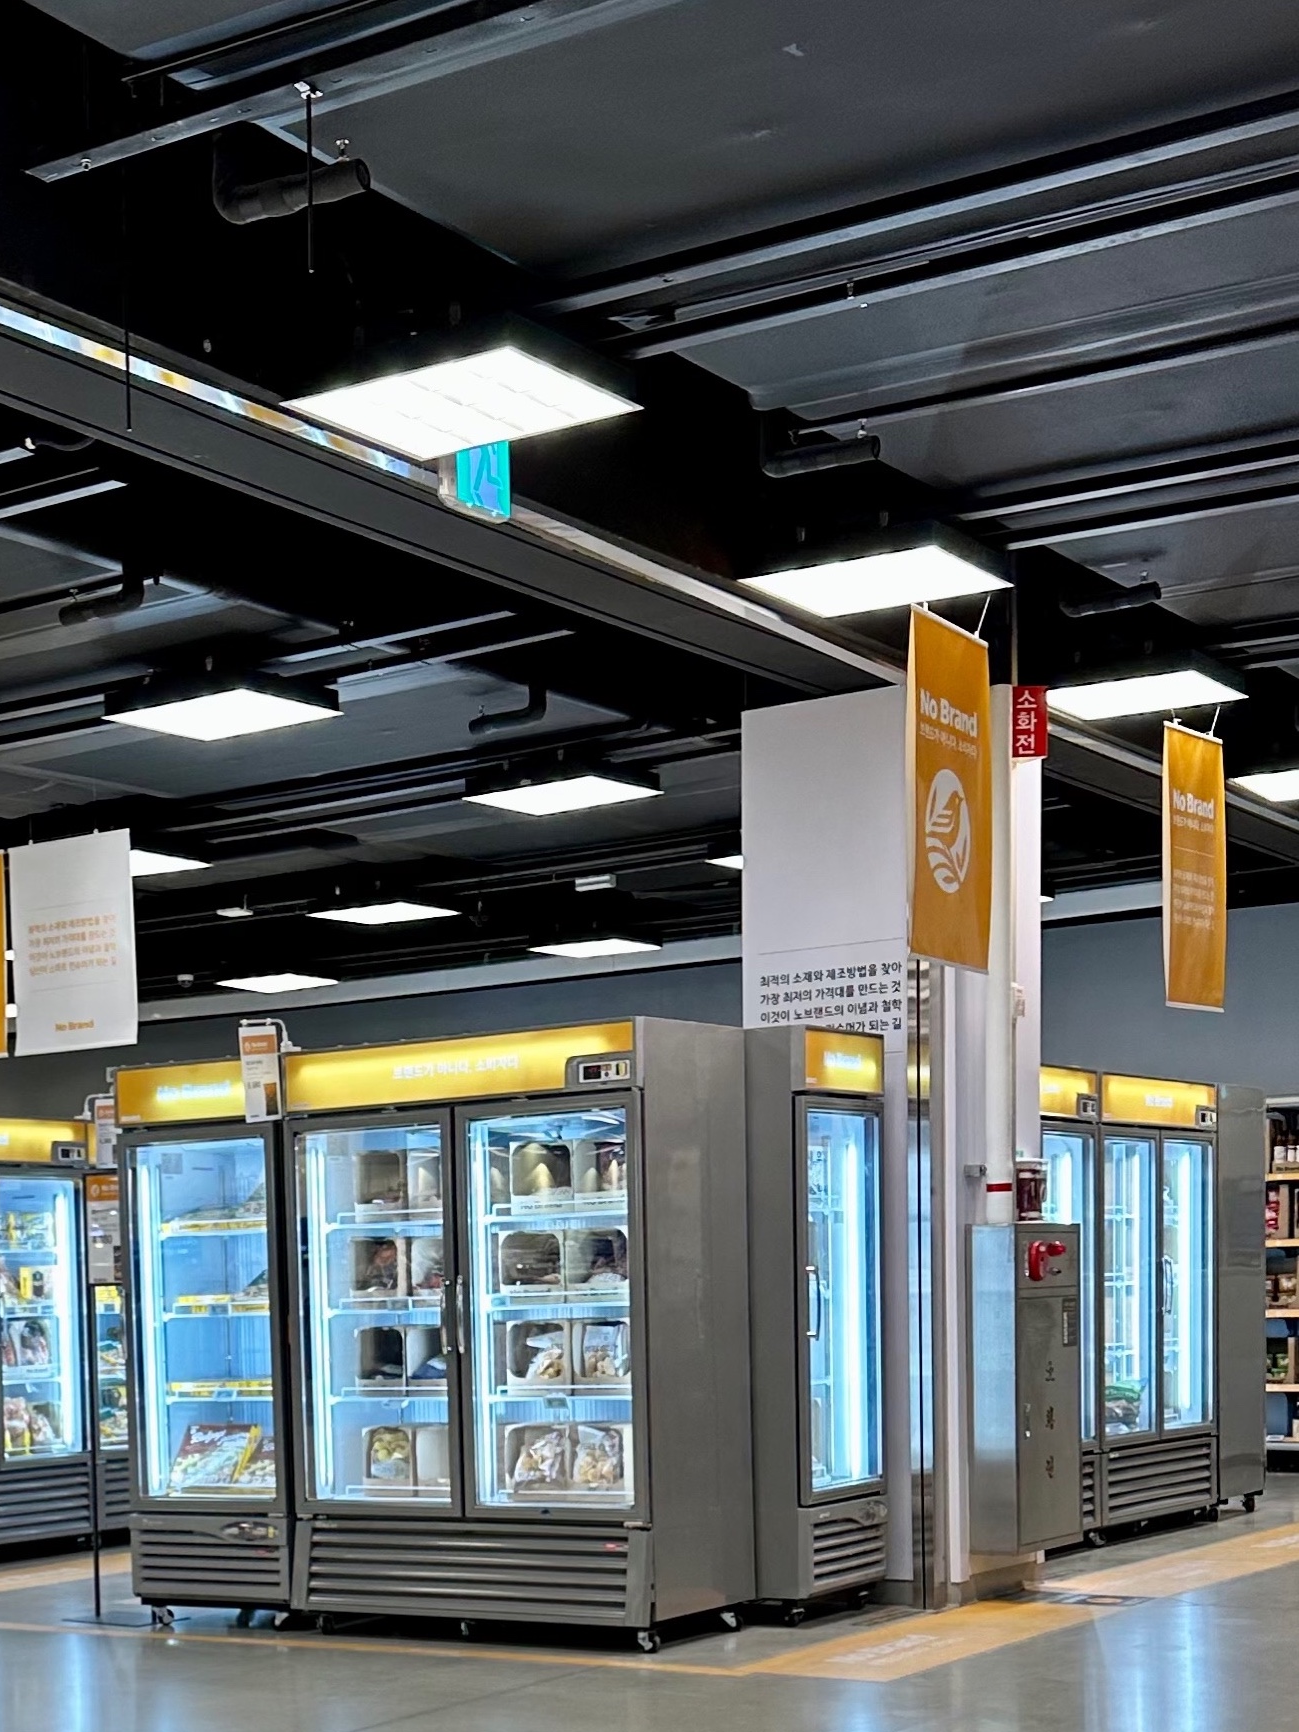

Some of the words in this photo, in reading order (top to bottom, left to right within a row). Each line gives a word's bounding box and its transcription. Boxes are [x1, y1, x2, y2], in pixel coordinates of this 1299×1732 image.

[920, 687, 938, 719] No
[940, 697, 977, 738] Brand
[1015, 689, 1038, 755] 소화전
[1173, 788, 1186, 811] No
[1187, 793, 1214, 819] Brand
[760, 974, 790, 987] 최적의
[793, 970, 824, 984] 소재와
[825, 964, 877, 980] 제조방법을
[881, 961, 902, 975] 찾아
[760, 993, 780, 1006] 가장
[783, 990, 812, 1003] 최저의
[815, 984, 854, 999] 가격대를
[858, 981, 888, 996] 만드는
[891, 980, 901, 993] 것
[760, 1011, 790, 1023] 이것이
[794, 1004, 844, 1020] 노브랜드의
[847, 1001, 878, 1015] 이념과
[881, 999, 902, 1013] 철학
[869, 1019, 889, 1031] 되는
[892, 1017, 902, 1030] 길
